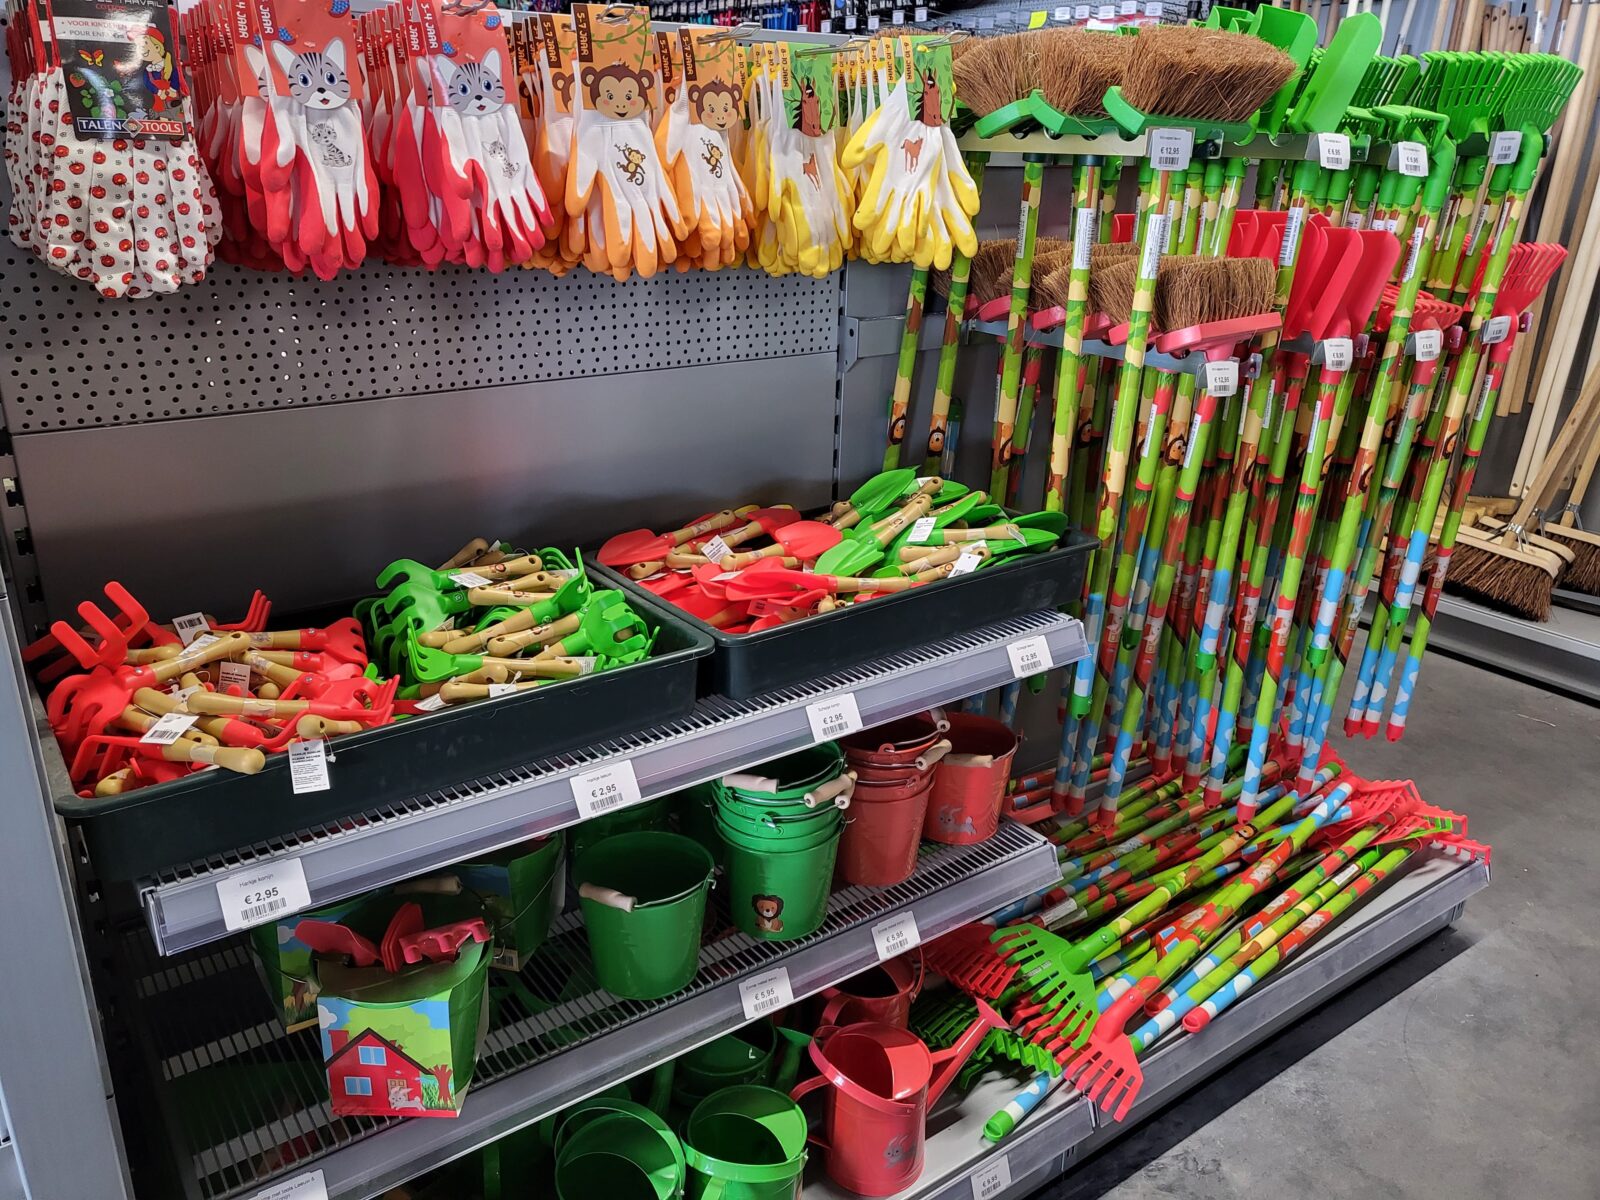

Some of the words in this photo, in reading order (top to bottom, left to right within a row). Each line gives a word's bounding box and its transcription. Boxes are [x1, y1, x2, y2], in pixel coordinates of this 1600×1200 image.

[260, 5, 274, 34] JAAR
[421, 3, 432, 20] 3-4
[236, 11, 249, 38] JAAR
[543, 22, 553, 36] 5-7
[577, 12, 586, 30] 5-7
[409, 25, 420, 51] JAAR
[426, 23, 438, 48] JAAR
[580, 32, 588, 56] JAAR
[682, 36, 691, 50] 5-7
[547, 39, 557, 62] JAAR
[662, 55, 670, 77] JAAR
[685, 53, 694, 75] JAAR
[79, 120, 122, 130] TALEN
[142, 122, 182, 133] TOOLS
[1026, 652, 1037, 661] 2,95
[829, 713, 843, 723] 2,95
[599, 784, 616, 796] 2,95
[240, 879, 257, 888] Harkje
[258, 873, 274, 882] konijn
[245, 895, 252, 904] €
[255, 887, 279, 902] 2,95
[892, 931, 904, 940] 5,95
[760, 988, 775, 998] 5,95
